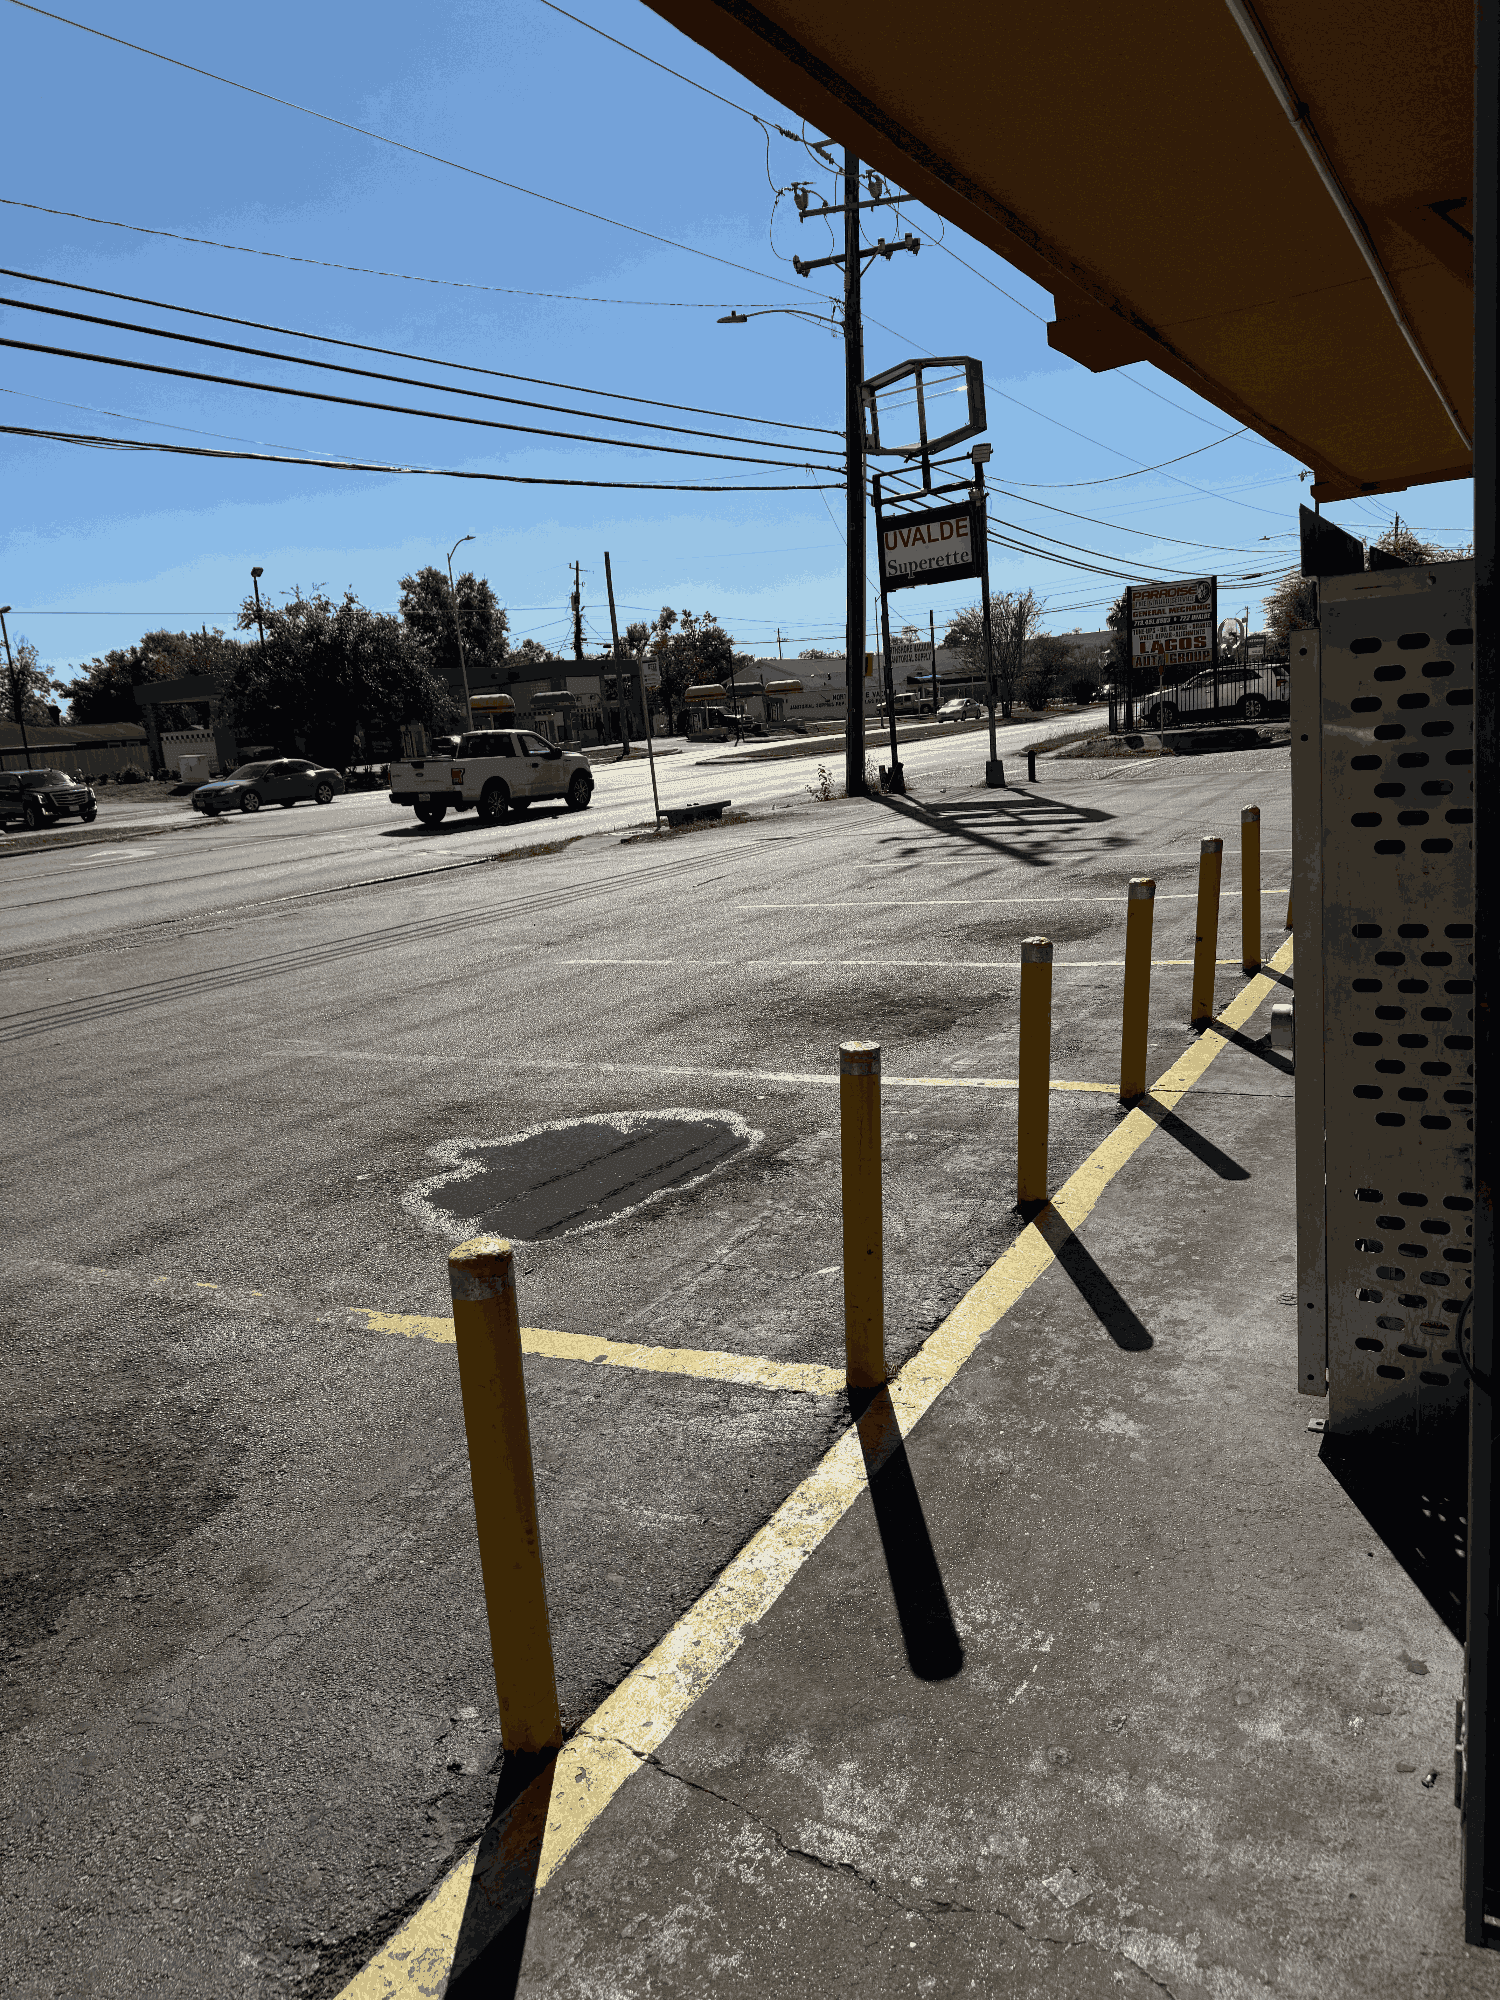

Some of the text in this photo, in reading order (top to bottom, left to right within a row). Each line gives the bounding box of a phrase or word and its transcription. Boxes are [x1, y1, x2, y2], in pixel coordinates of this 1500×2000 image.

[885, 518, 968, 551] UVALDE
[887, 551, 970, 579] Superette
[1132, 584, 1198, 601] PARADISE
[1133, 604, 1211, 618] GENERAL MECHANIC
[1139, 635, 1207, 654] LAGOS
[1135, 650, 1211, 668] AUT GROUP
